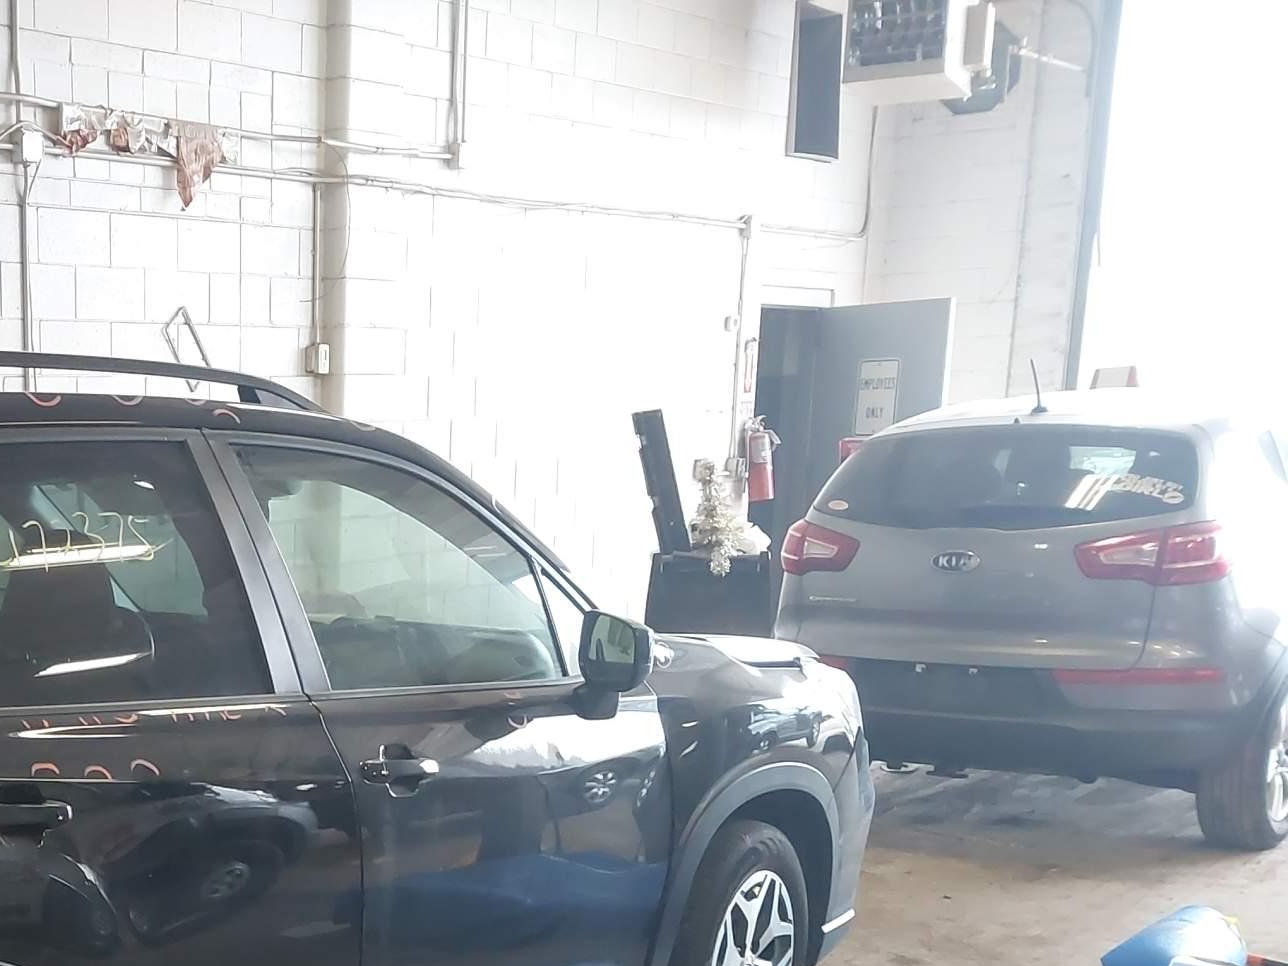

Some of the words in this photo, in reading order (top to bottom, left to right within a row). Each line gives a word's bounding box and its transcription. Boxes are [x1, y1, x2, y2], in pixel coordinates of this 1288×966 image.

[859, 377, 897, 391] EMPLOYEES
[865, 407, 884, 419] ONLY
[937, 554, 974, 569] KIA
